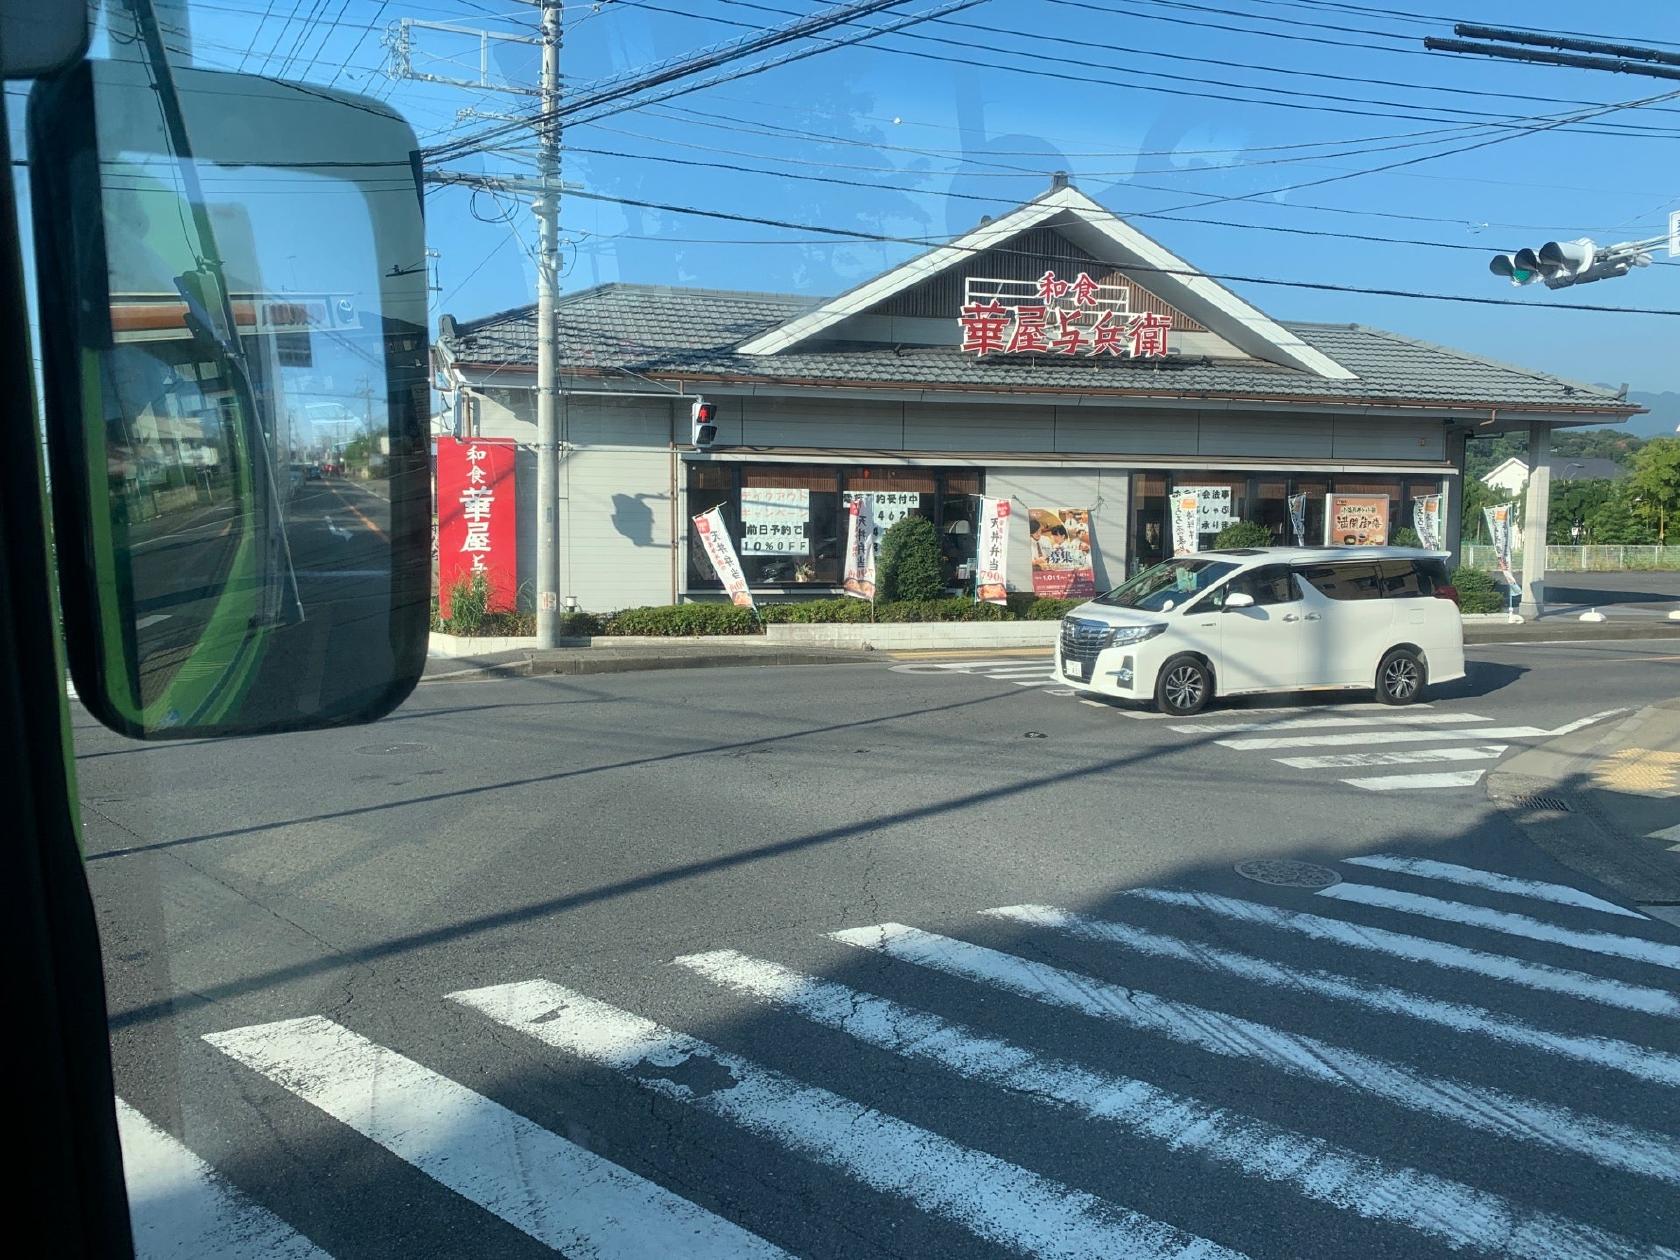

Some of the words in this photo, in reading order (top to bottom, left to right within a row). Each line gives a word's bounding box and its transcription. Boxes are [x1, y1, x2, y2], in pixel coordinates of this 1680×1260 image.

[1038, 270, 1099, 306] 和食
[960, 299, 1172, 358] 華屋与兵衛
[742, 491, 808, 501] テイクアウト
[742, 508, 809, 517] キャンペーン
[746, 524, 803, 535] 前日予約で
[989, 517, 1000, 571] 天丼弁当
